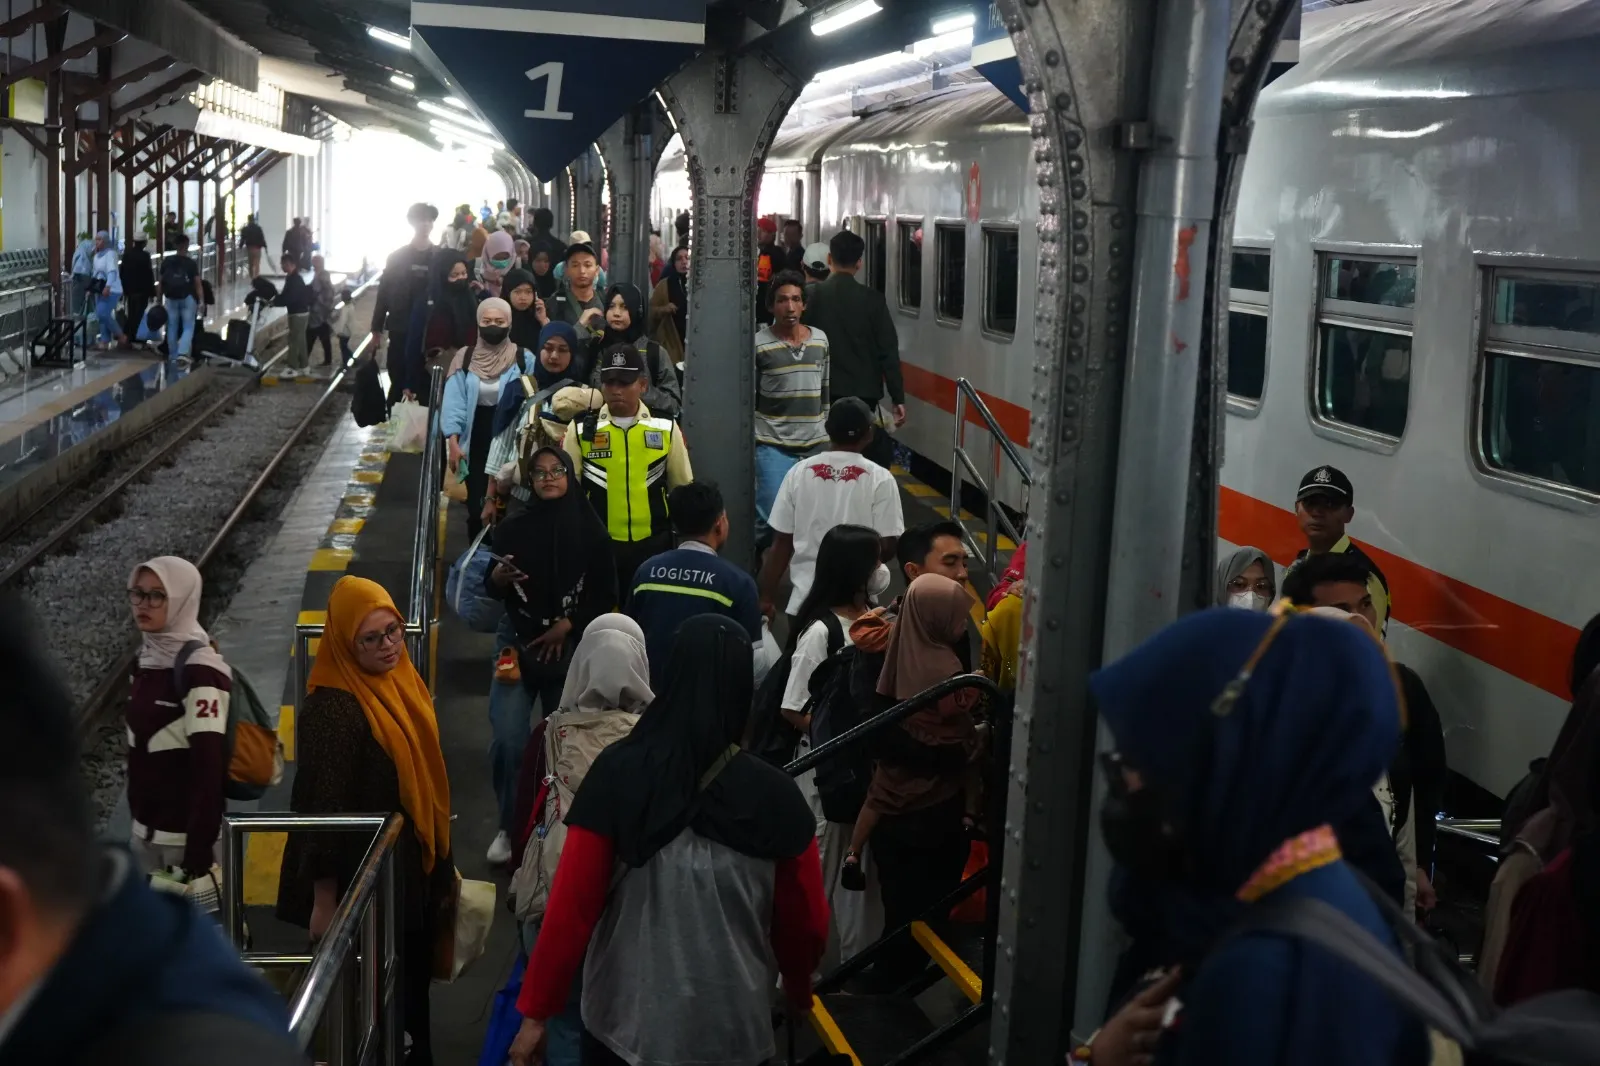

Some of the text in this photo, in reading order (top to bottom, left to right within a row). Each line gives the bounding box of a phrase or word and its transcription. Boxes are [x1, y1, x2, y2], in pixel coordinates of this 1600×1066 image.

[524, 62, 573, 120] 1
[650, 566, 717, 585] LOGISTIK
[195, 699, 218, 718] 24
